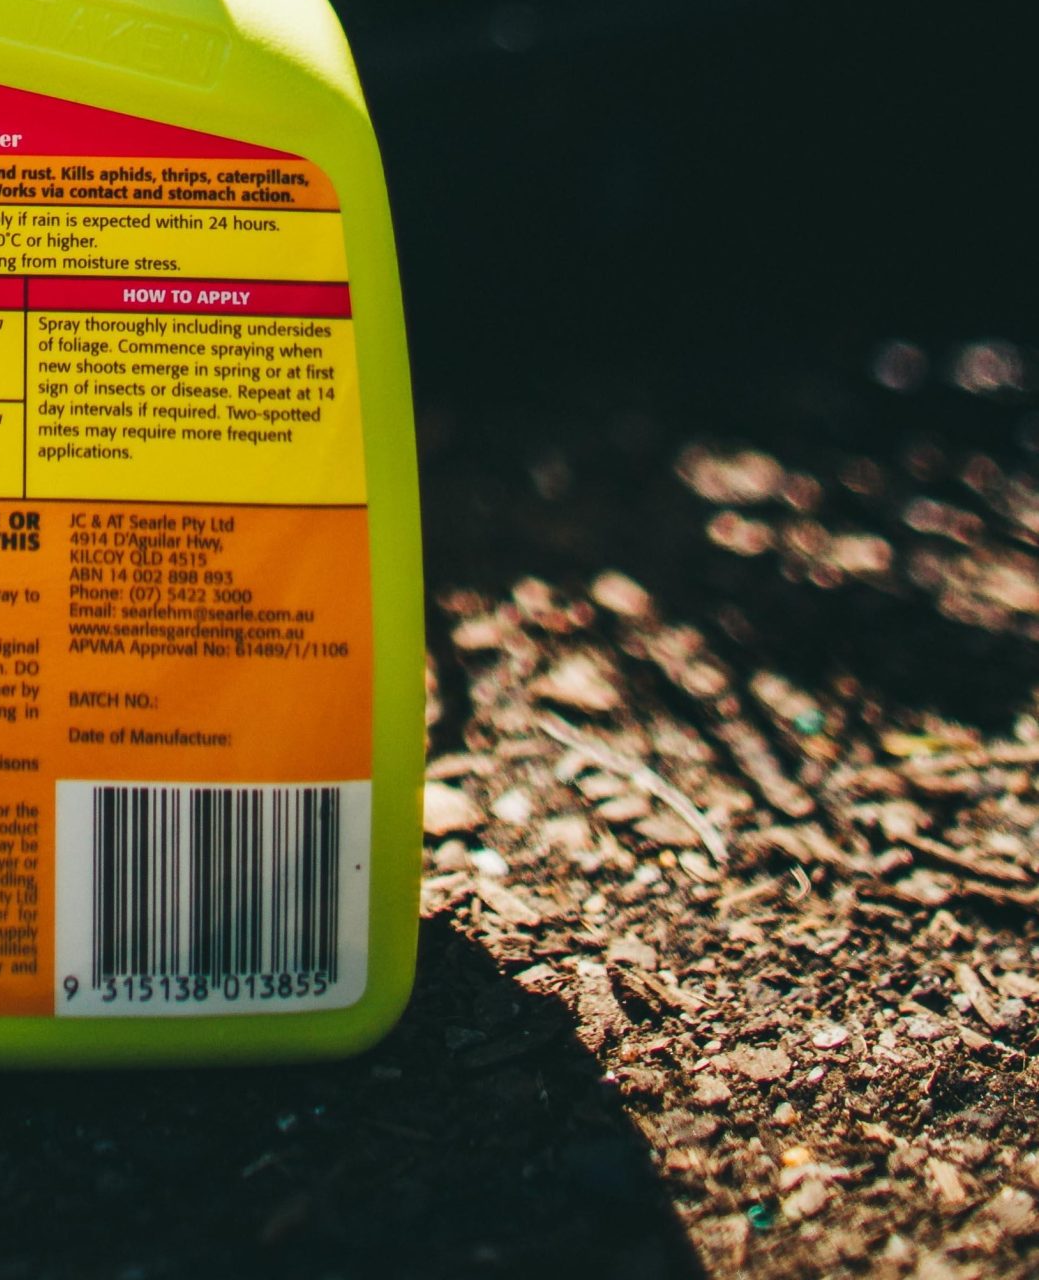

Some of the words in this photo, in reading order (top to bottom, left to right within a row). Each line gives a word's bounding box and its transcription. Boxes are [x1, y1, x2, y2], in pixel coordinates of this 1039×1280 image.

[20, 167, 55, 183] rust.
[62, 165, 94, 181] Kills
[100, 166, 156, 188] aphids,
[160, 168, 211, 189] thrips,
[217, 168, 309, 190] caterpillars,
[42, 183, 64, 198] via
[70, 185, 128, 199] contact
[133, 185, 162, 200] and
[169, 186, 235, 201] stomach
[241, 187, 294, 203] action.
[19, 211, 27, 226] if
[33, 211, 60, 227] rain
[66, 213, 77, 227] is
[83, 213, 150, 231] expected
[156, 213, 202, 230] within
[210, 216, 227, 230] 24
[234, 215, 279, 232] hours.
[27, 236, 41, 248] or
[48, 233, 97, 252] higher.
[22, 252, 56, 269] from
[63, 254, 129, 270] moisture
[135, 257, 180, 271] stress.
[124, 288, 166, 303] HOW
[171, 289, 192, 304] TO
[197, 290, 250, 305] APPLY
[39, 317, 80, 335] Spray
[86, 316, 167, 337] thoroughly
[173, 318, 241, 339] including
[248, 321, 331, 338] undersides
[9, 511, 40, 530] OR
[70, 513, 86, 529] JC
[92, 514, 101, 529] &
[107, 514, 124, 531] AT
[130, 514, 176, 533] Searle
[182, 516, 205, 536] Pty
[211, 516, 234, 533] Ltd
[70, 531, 107, 546] 4914
[70, 549, 124, 567] KILCOY
[130, 548, 163, 569] QLD
[169, 552, 207, 568] 4515
[69, 691, 119, 708] BATCH
[69, 728, 104, 743] Date
[110, 728, 125, 745] of
[130, 728, 231, 746] Manufacture:
[62, 975, 80, 1001] 9
[102, 975, 209, 1002] 315138
[223, 972, 329, 1001] 013855
